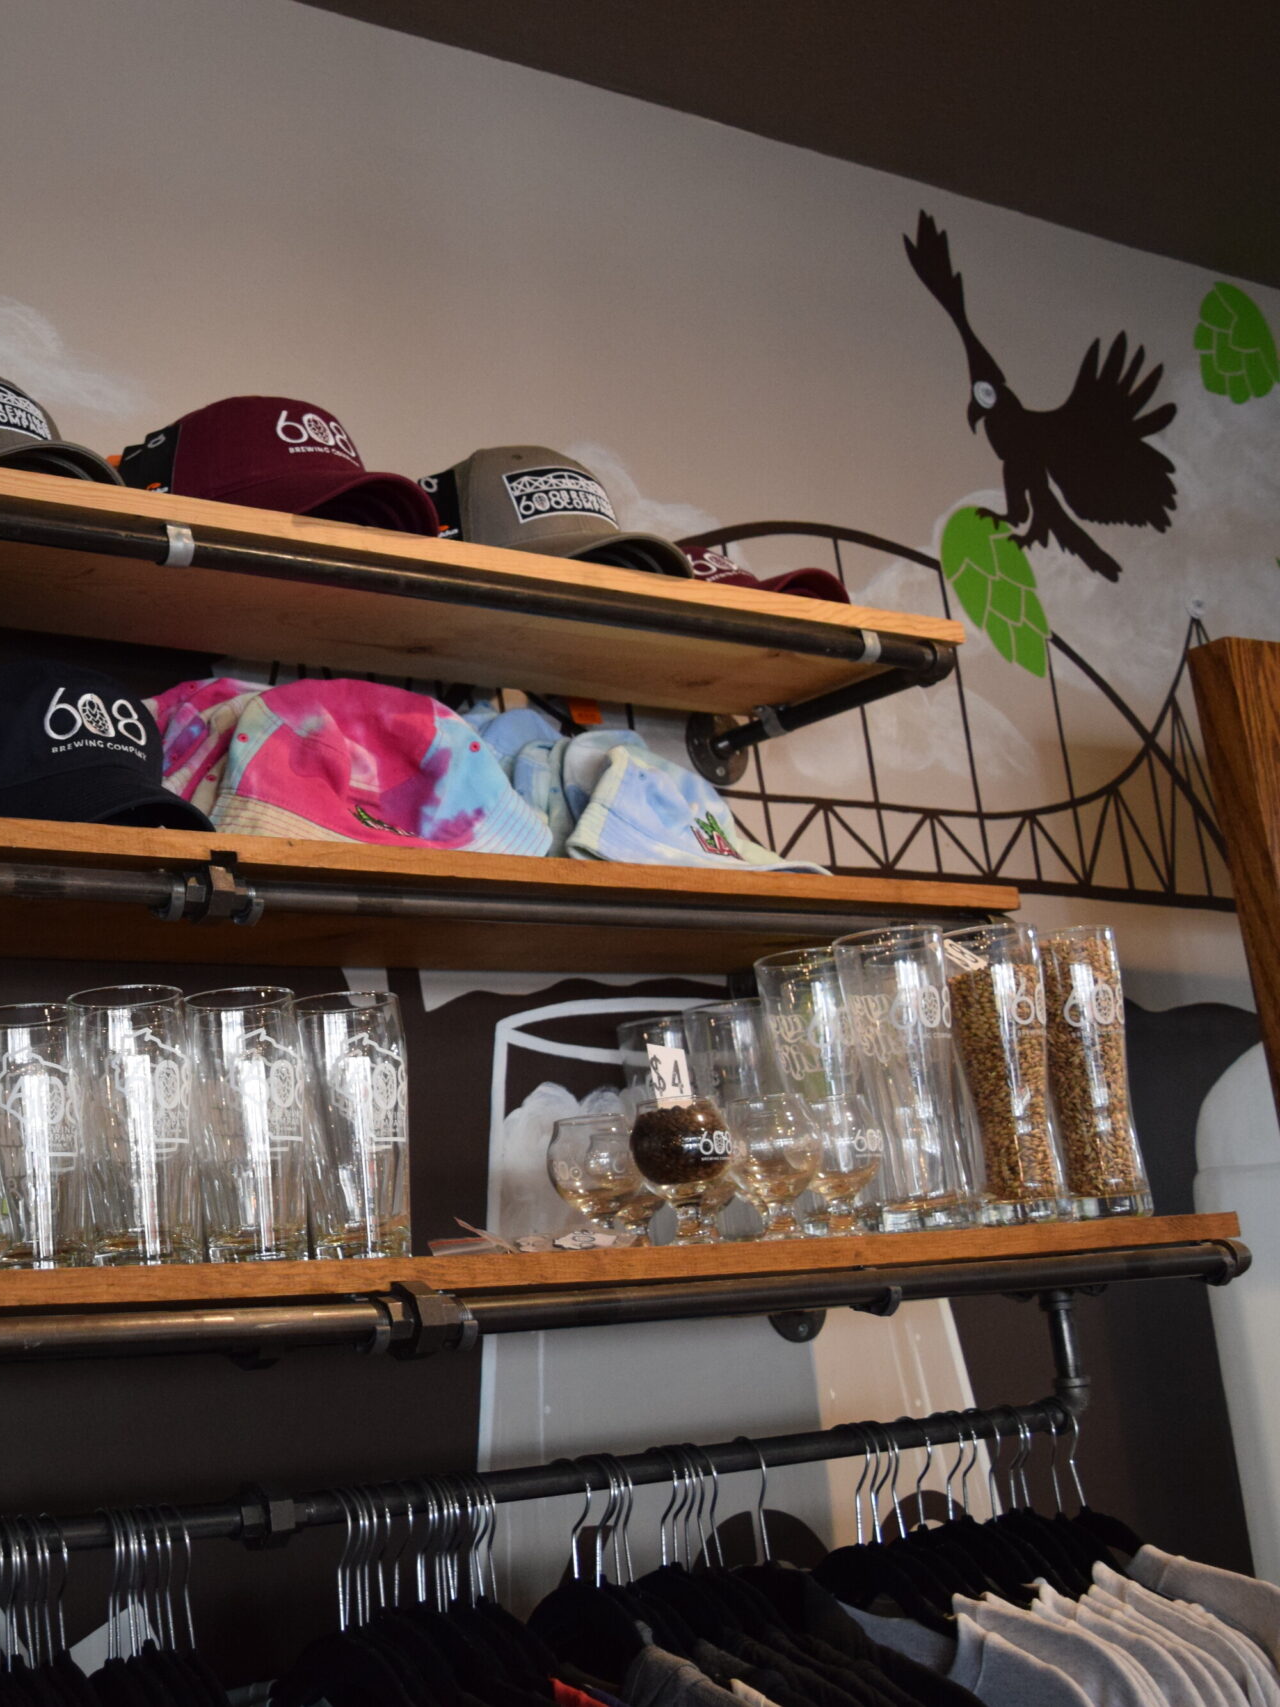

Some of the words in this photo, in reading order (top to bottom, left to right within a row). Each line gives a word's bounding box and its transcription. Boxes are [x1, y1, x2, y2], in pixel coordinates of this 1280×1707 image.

[276, 410, 357, 457] 608
[520, 490, 566, 515] 608
[44, 687, 147, 746] 608
[51, 738, 105, 754] BREWING
[699, 1130, 733, 1156] 608
